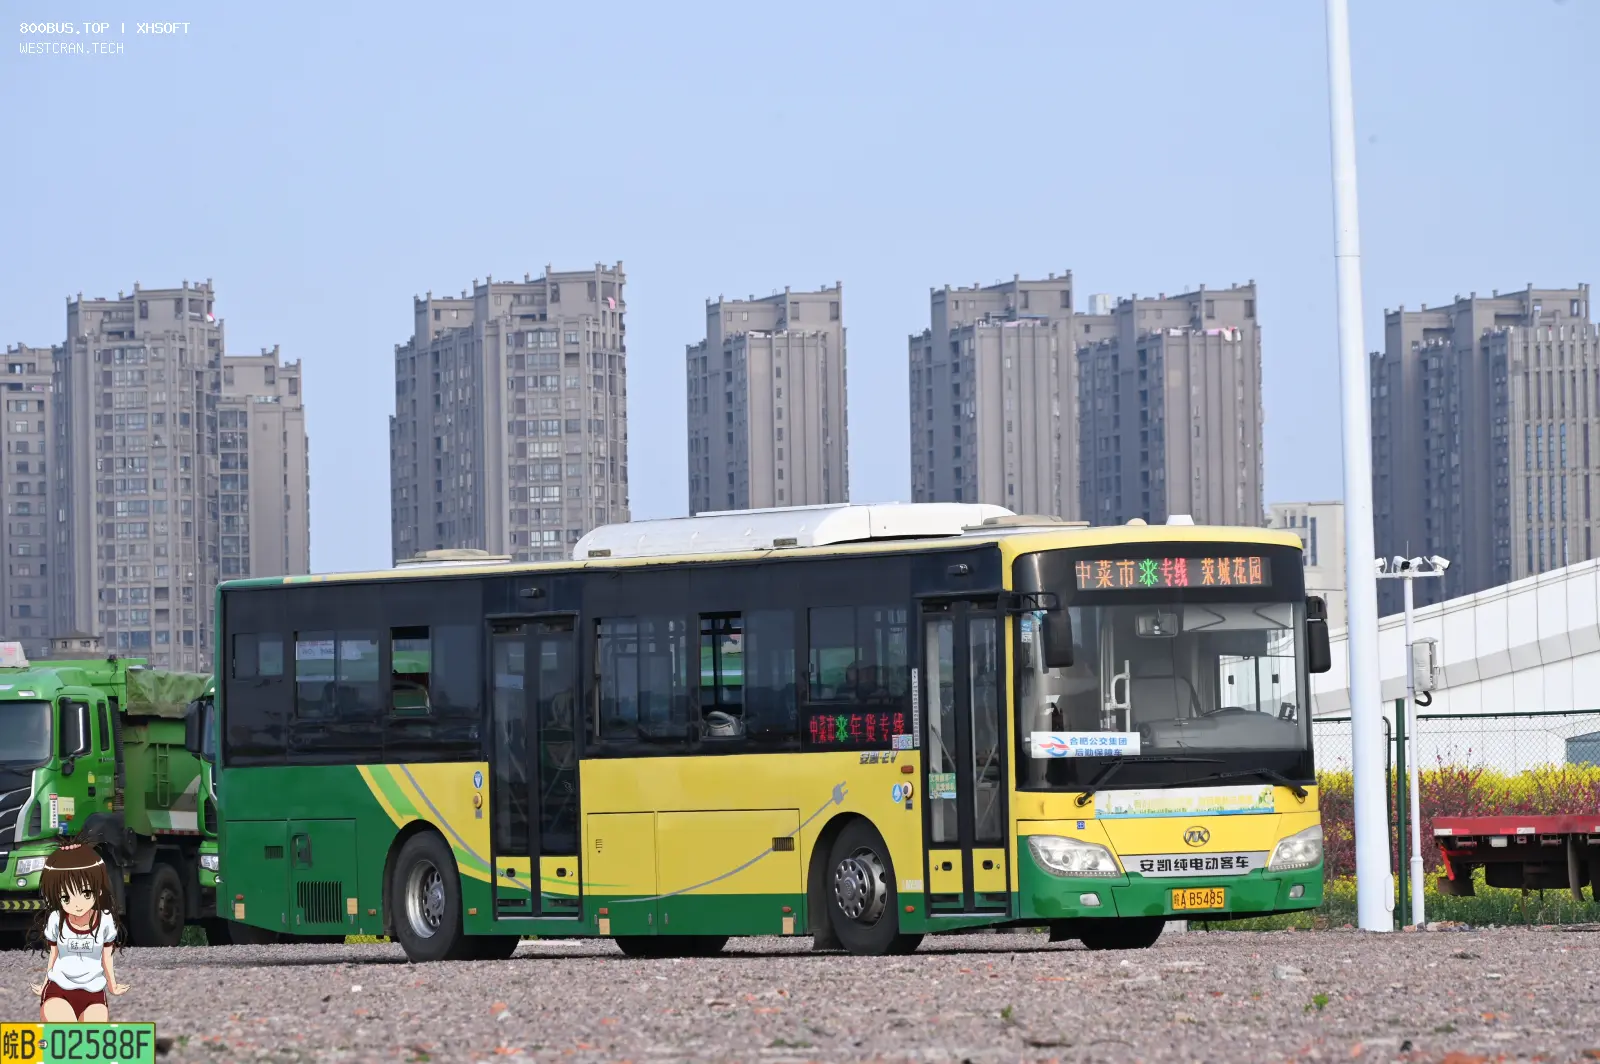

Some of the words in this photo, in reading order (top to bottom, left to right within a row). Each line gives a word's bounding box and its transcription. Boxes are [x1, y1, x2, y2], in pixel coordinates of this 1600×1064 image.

[1069, 736, 1128, 746] 合肥公交集团
[1074, 748, 1123, 757] 后勤保障车
[1139, 855, 1249, 873] 安凯纯电动客车
